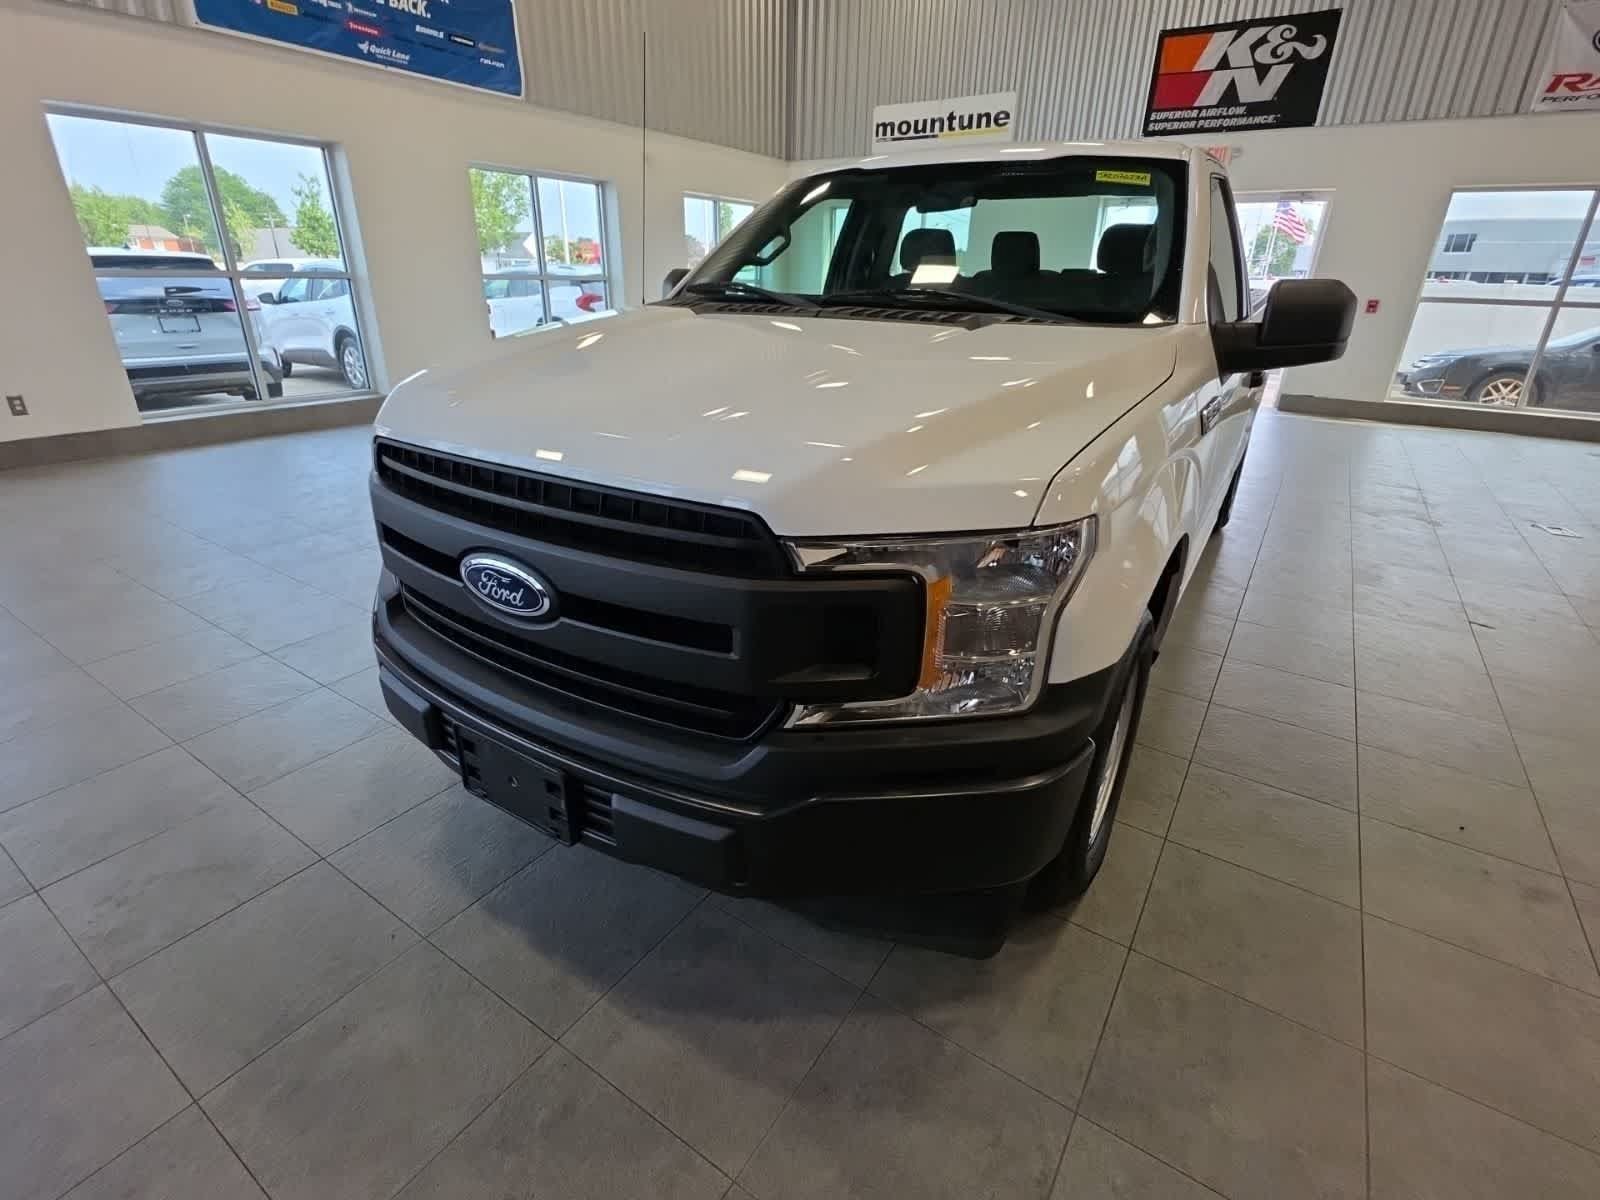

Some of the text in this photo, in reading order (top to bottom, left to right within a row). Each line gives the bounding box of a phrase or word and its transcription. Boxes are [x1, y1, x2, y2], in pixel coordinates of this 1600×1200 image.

[369, 44, 392, 56] Quick
[392, 50, 411, 61] Lane
[1150, 106, 1247, 120] SUPERIOR AIRFLOW.
[875, 110, 1010, 138] mountune
[1147, 120, 1197, 131] SUPERIOR
[478, 569, 524, 606] Ford
